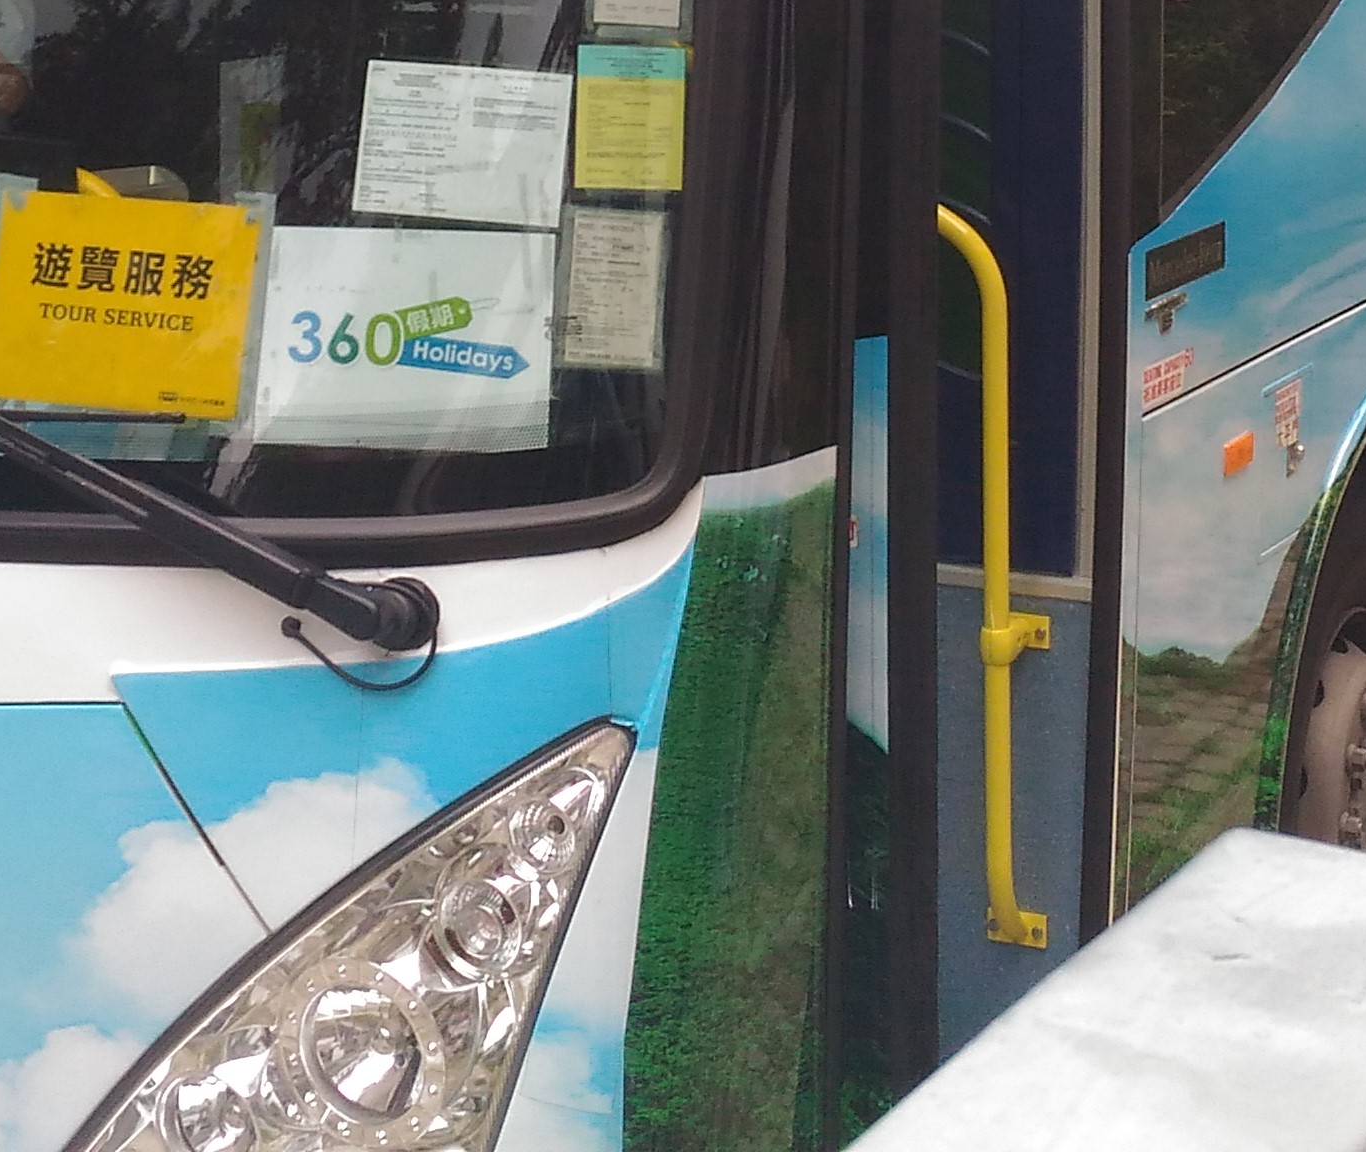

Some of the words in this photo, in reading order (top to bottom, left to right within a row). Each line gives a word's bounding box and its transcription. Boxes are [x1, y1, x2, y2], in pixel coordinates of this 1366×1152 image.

[31, 242, 214, 300] 遊覽服務
[39, 302, 97, 324] TOUR
[103, 308, 194, 332] SERVICE
[406, 304, 455, 334] 假期
[287, 310, 402, 367] 360
[412, 339, 514, 372] Holidays
